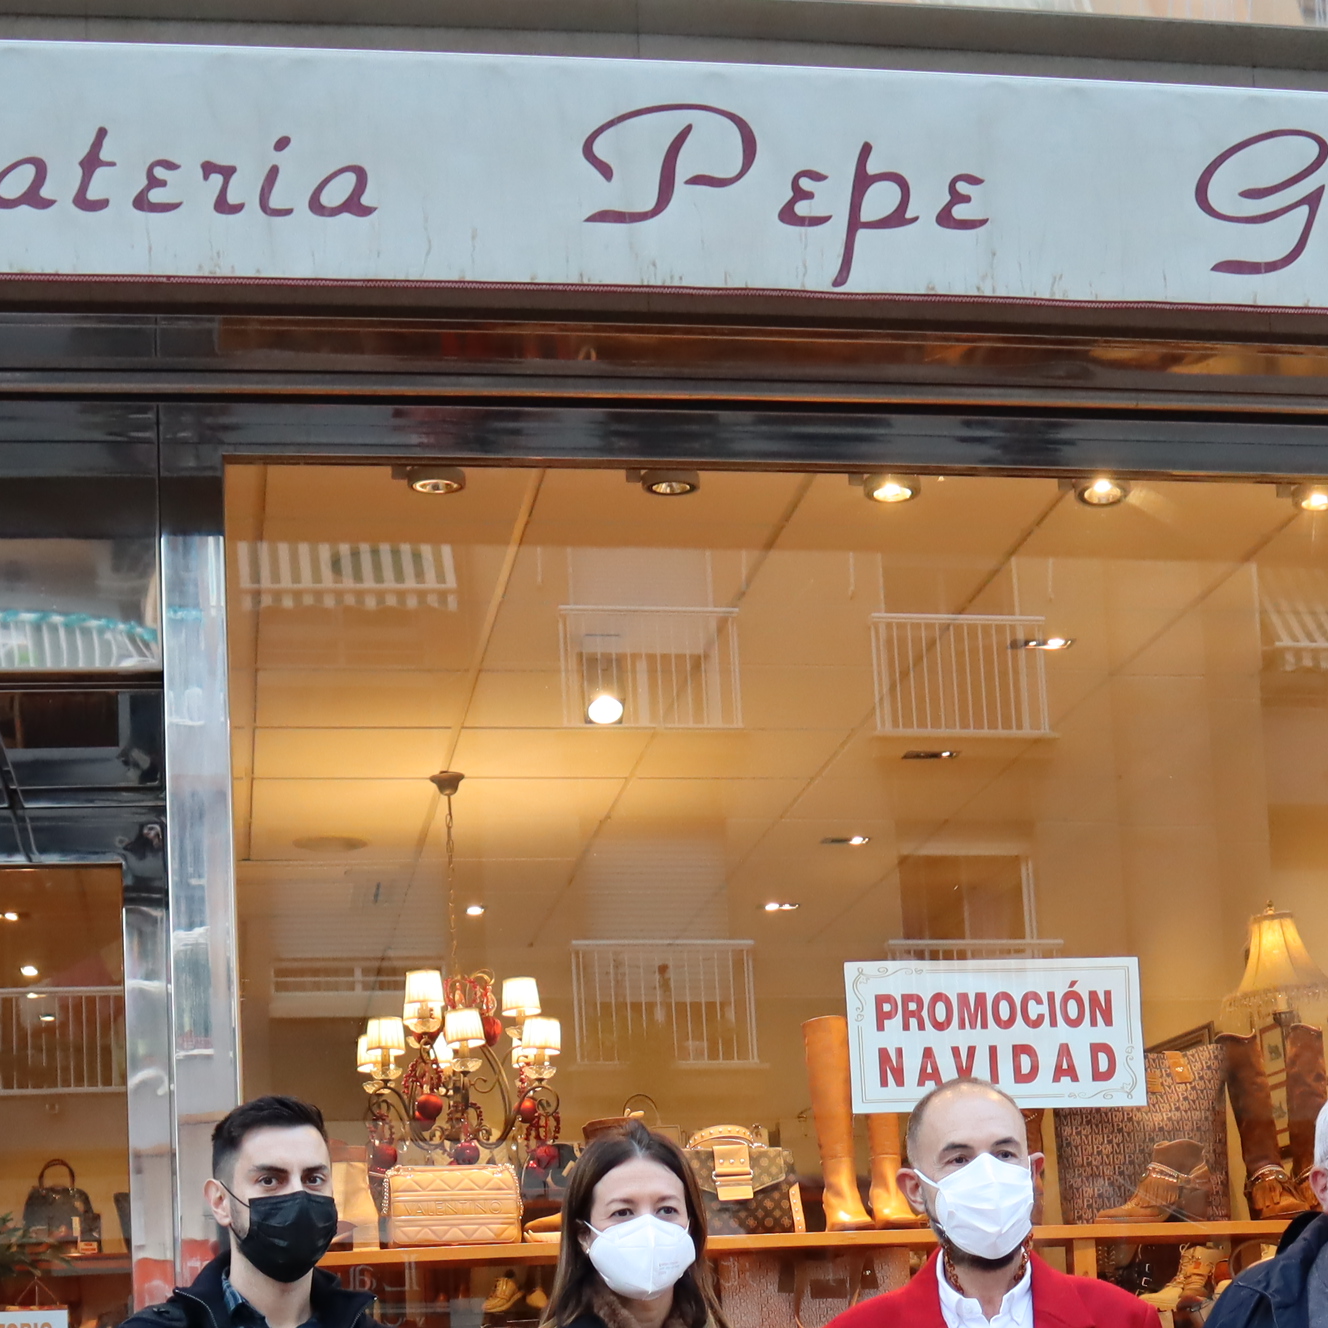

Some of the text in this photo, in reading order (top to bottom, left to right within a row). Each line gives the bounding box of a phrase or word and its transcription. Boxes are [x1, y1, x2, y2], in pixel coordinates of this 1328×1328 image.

[582, 102, 990, 288] Pepe
[874, 980, 1114, 1032] PROMOCIÓN
[877, 1042, 1118, 1088] NAVIDAD
